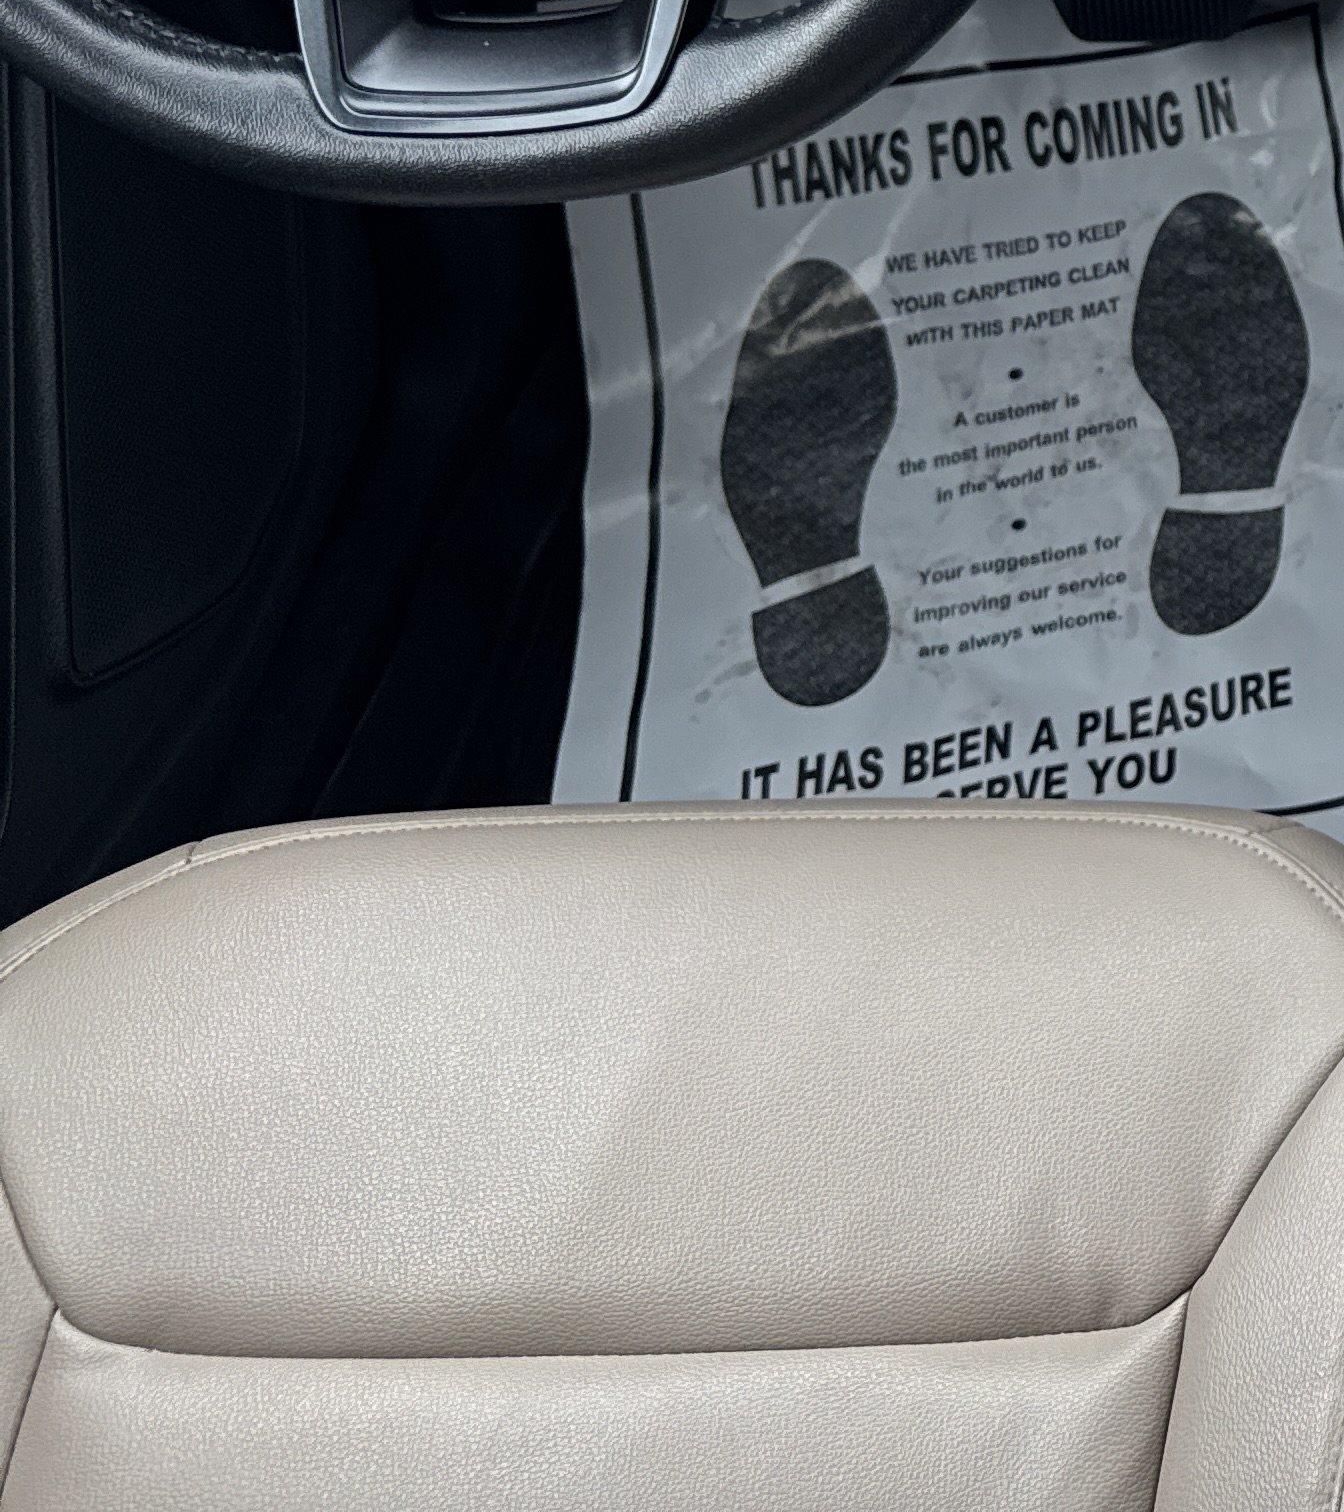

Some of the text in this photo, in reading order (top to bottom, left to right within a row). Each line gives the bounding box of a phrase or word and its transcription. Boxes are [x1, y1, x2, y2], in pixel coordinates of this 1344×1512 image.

[748, 76, 1239, 210] THANKS FOR COMING IN
[885, 219, 1127, 276] WE HAVE TRIED TO KEEP
[892, 257, 1131, 316] YOUR CARPETING CLEAN
[905, 296, 1121, 347] WITH THIS PAPER MAT
[954, 391, 1080, 429] A customer is
[898, 415, 1138, 477] the most important person
[935, 456, 1102, 504] in the world to us.
[918, 532, 1122, 587] Your suggestions for
[913, 570, 1127, 624] improving our service
[918, 606, 1123, 659] are always welcome.
[739, 760, 782, 800] IT
[795, 746, 884, 800] HAS
[903, 721, 1015, 786] BEEN
[1029, 717, 1059, 756] A
[1077, 667, 1294, 748] PLEASURE
[1086, 747, 1177, 796] YOU
